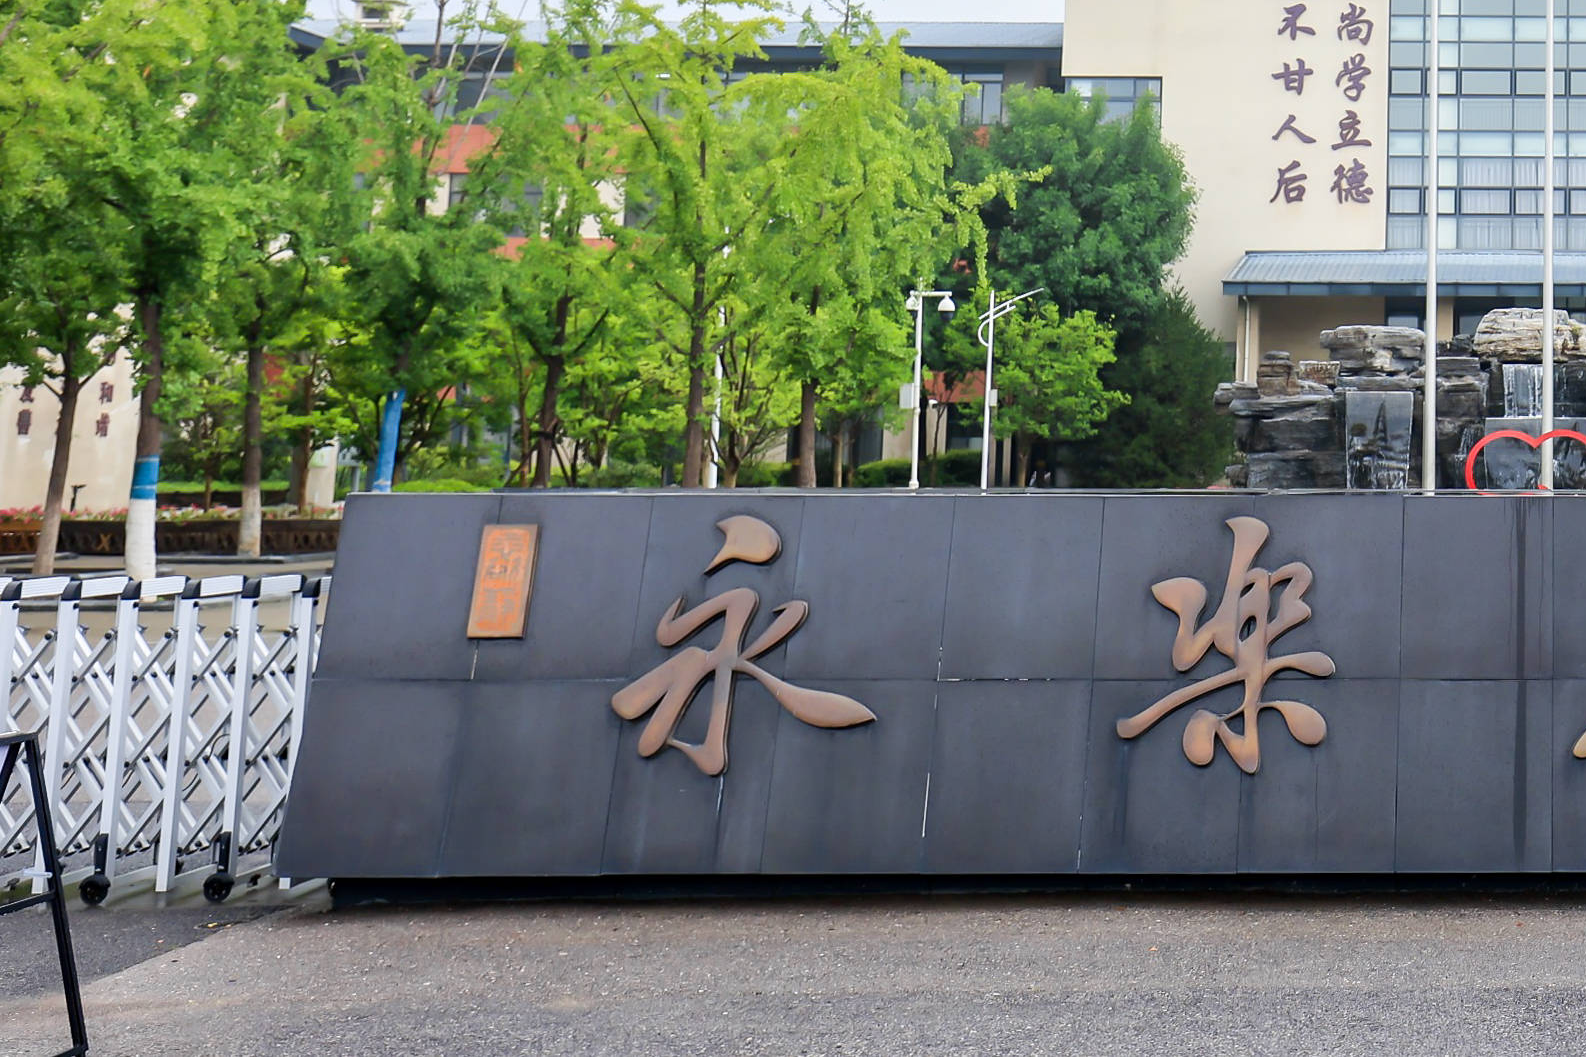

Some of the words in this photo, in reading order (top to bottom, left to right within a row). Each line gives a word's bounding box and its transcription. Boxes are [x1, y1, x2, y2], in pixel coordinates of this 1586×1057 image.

[1269, 3, 1317, 205] 不甘人后
[1329, 2, 1375, 205] 尚学立德
